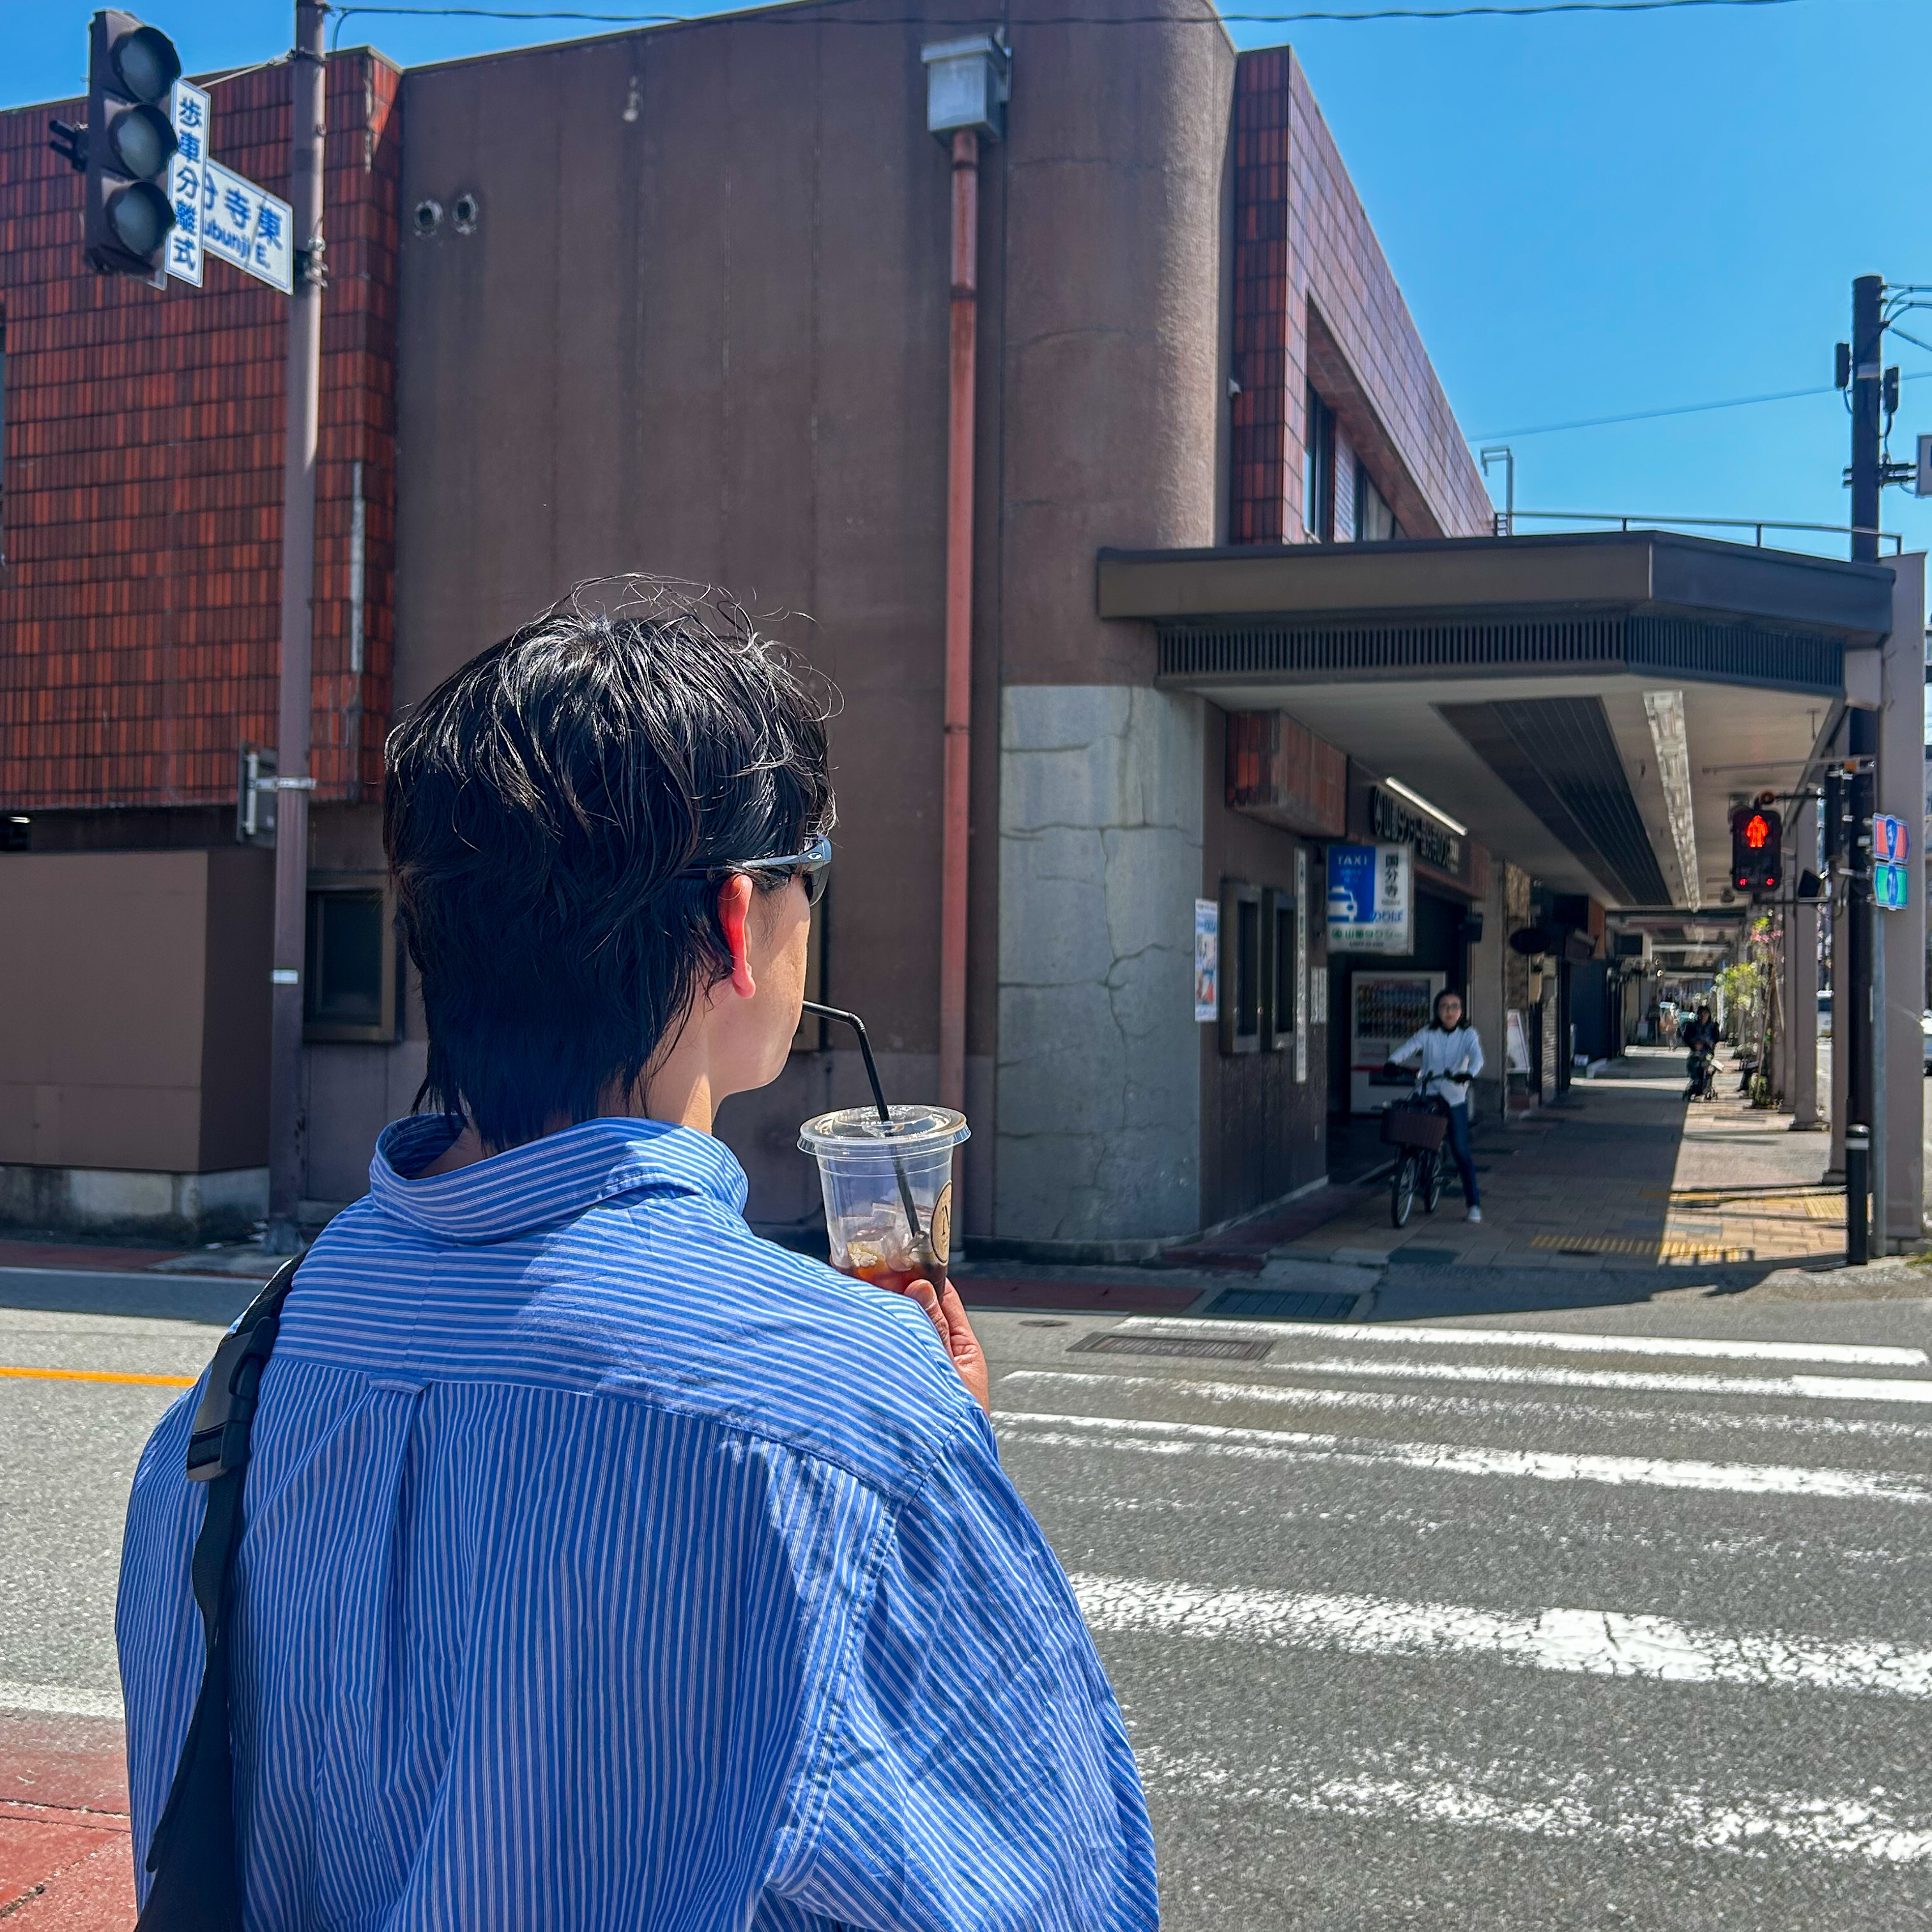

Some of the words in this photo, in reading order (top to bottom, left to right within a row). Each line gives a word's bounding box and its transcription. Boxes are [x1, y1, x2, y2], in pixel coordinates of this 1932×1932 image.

[173, 96, 202, 271] 歩車分離式
[1338, 854, 1367, 866] TAXI
